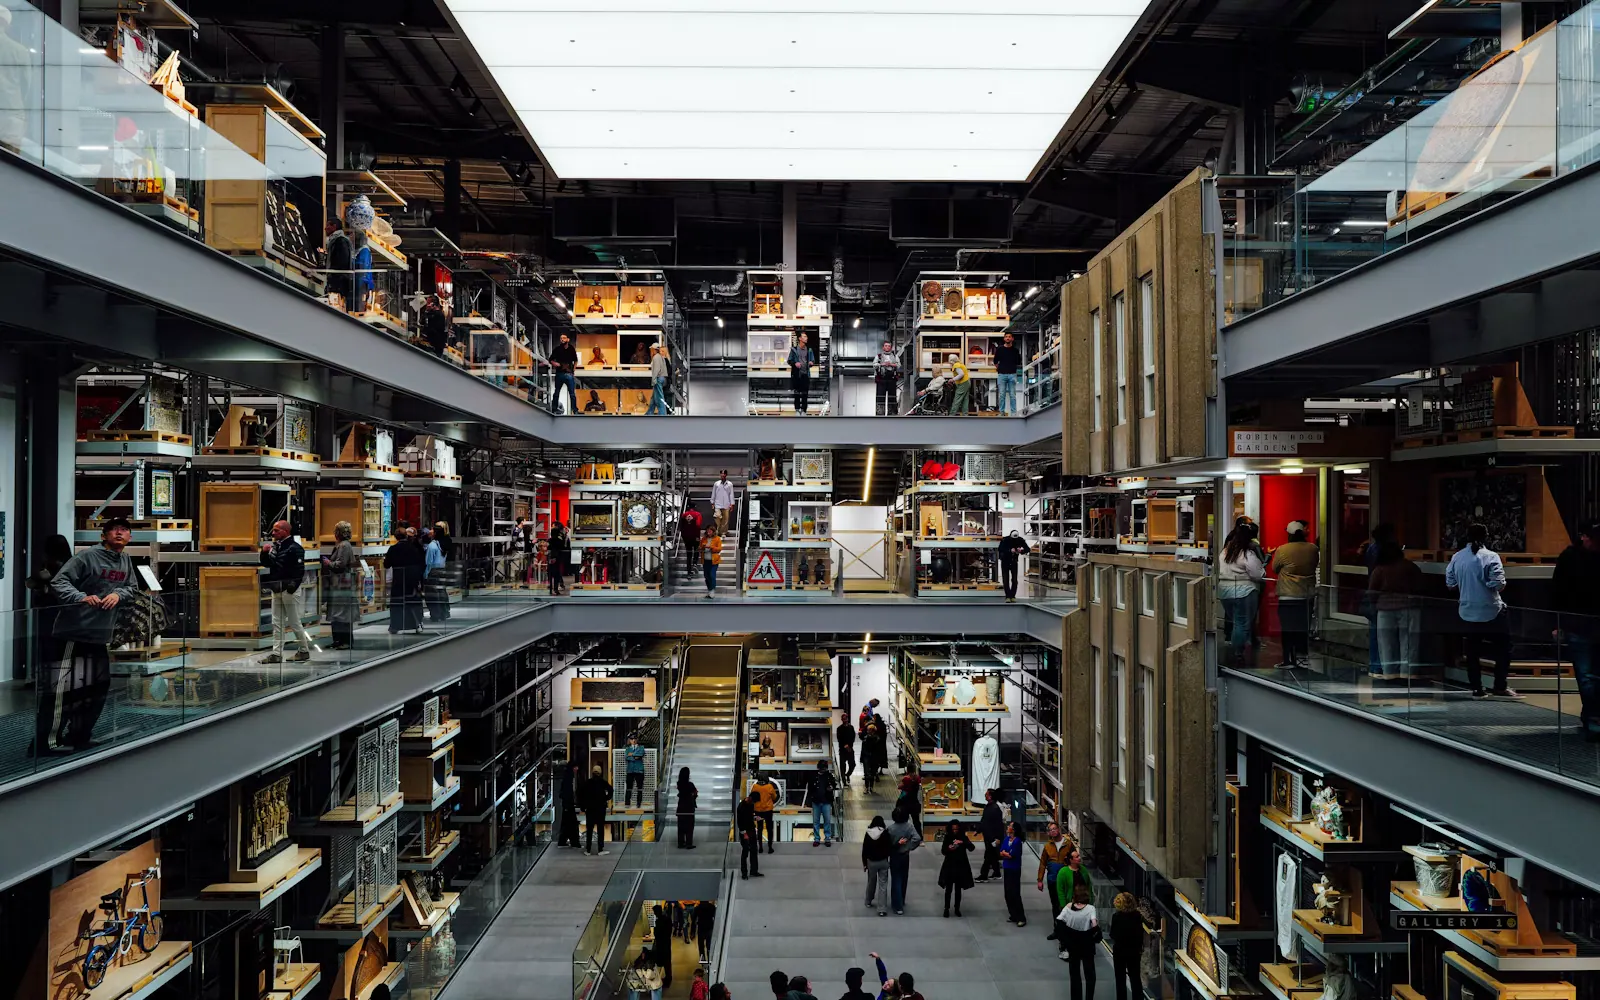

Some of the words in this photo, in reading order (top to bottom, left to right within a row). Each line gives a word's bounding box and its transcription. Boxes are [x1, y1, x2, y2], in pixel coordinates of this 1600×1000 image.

[1237, 433, 1278, 441] ROBIN
[1290, 433, 1322, 441] HOOD
[1399, 917, 1480, 927] GALLERY
[1496, 917, 1503, 927] 1
